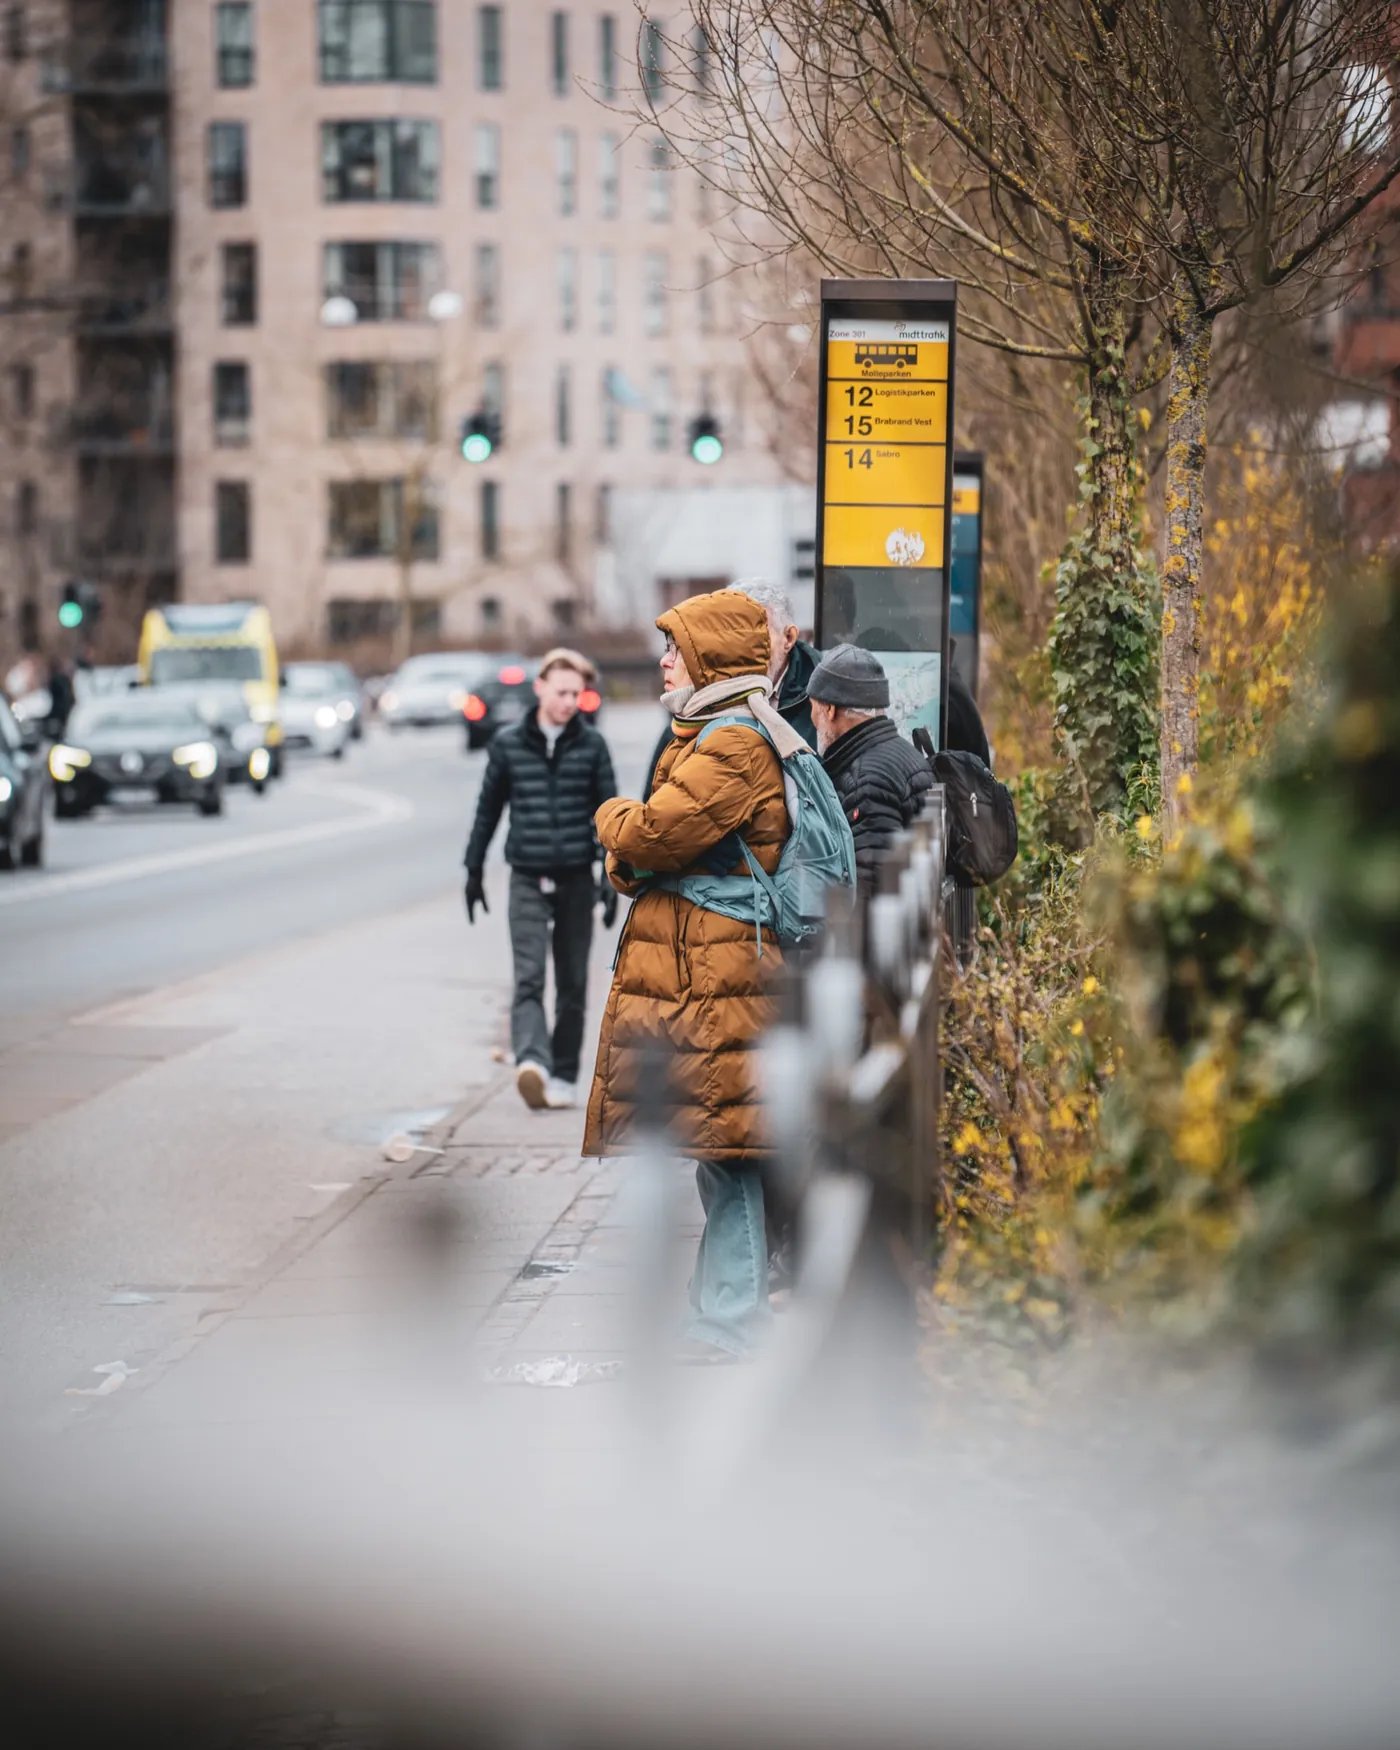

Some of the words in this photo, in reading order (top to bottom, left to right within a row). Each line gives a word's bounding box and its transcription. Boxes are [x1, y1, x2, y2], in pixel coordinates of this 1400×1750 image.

[829, 330, 850, 338] Zone
[899, 330, 946, 339] midttrafik
[844, 386, 873, 407] 12
[875, 389, 936, 398] Logistikparken
[844, 415, 873, 436] 15
[875, 417, 913, 426] Brabrand
[914, 418, 932, 426] Vest
[844, 448, 873, 470] 14
